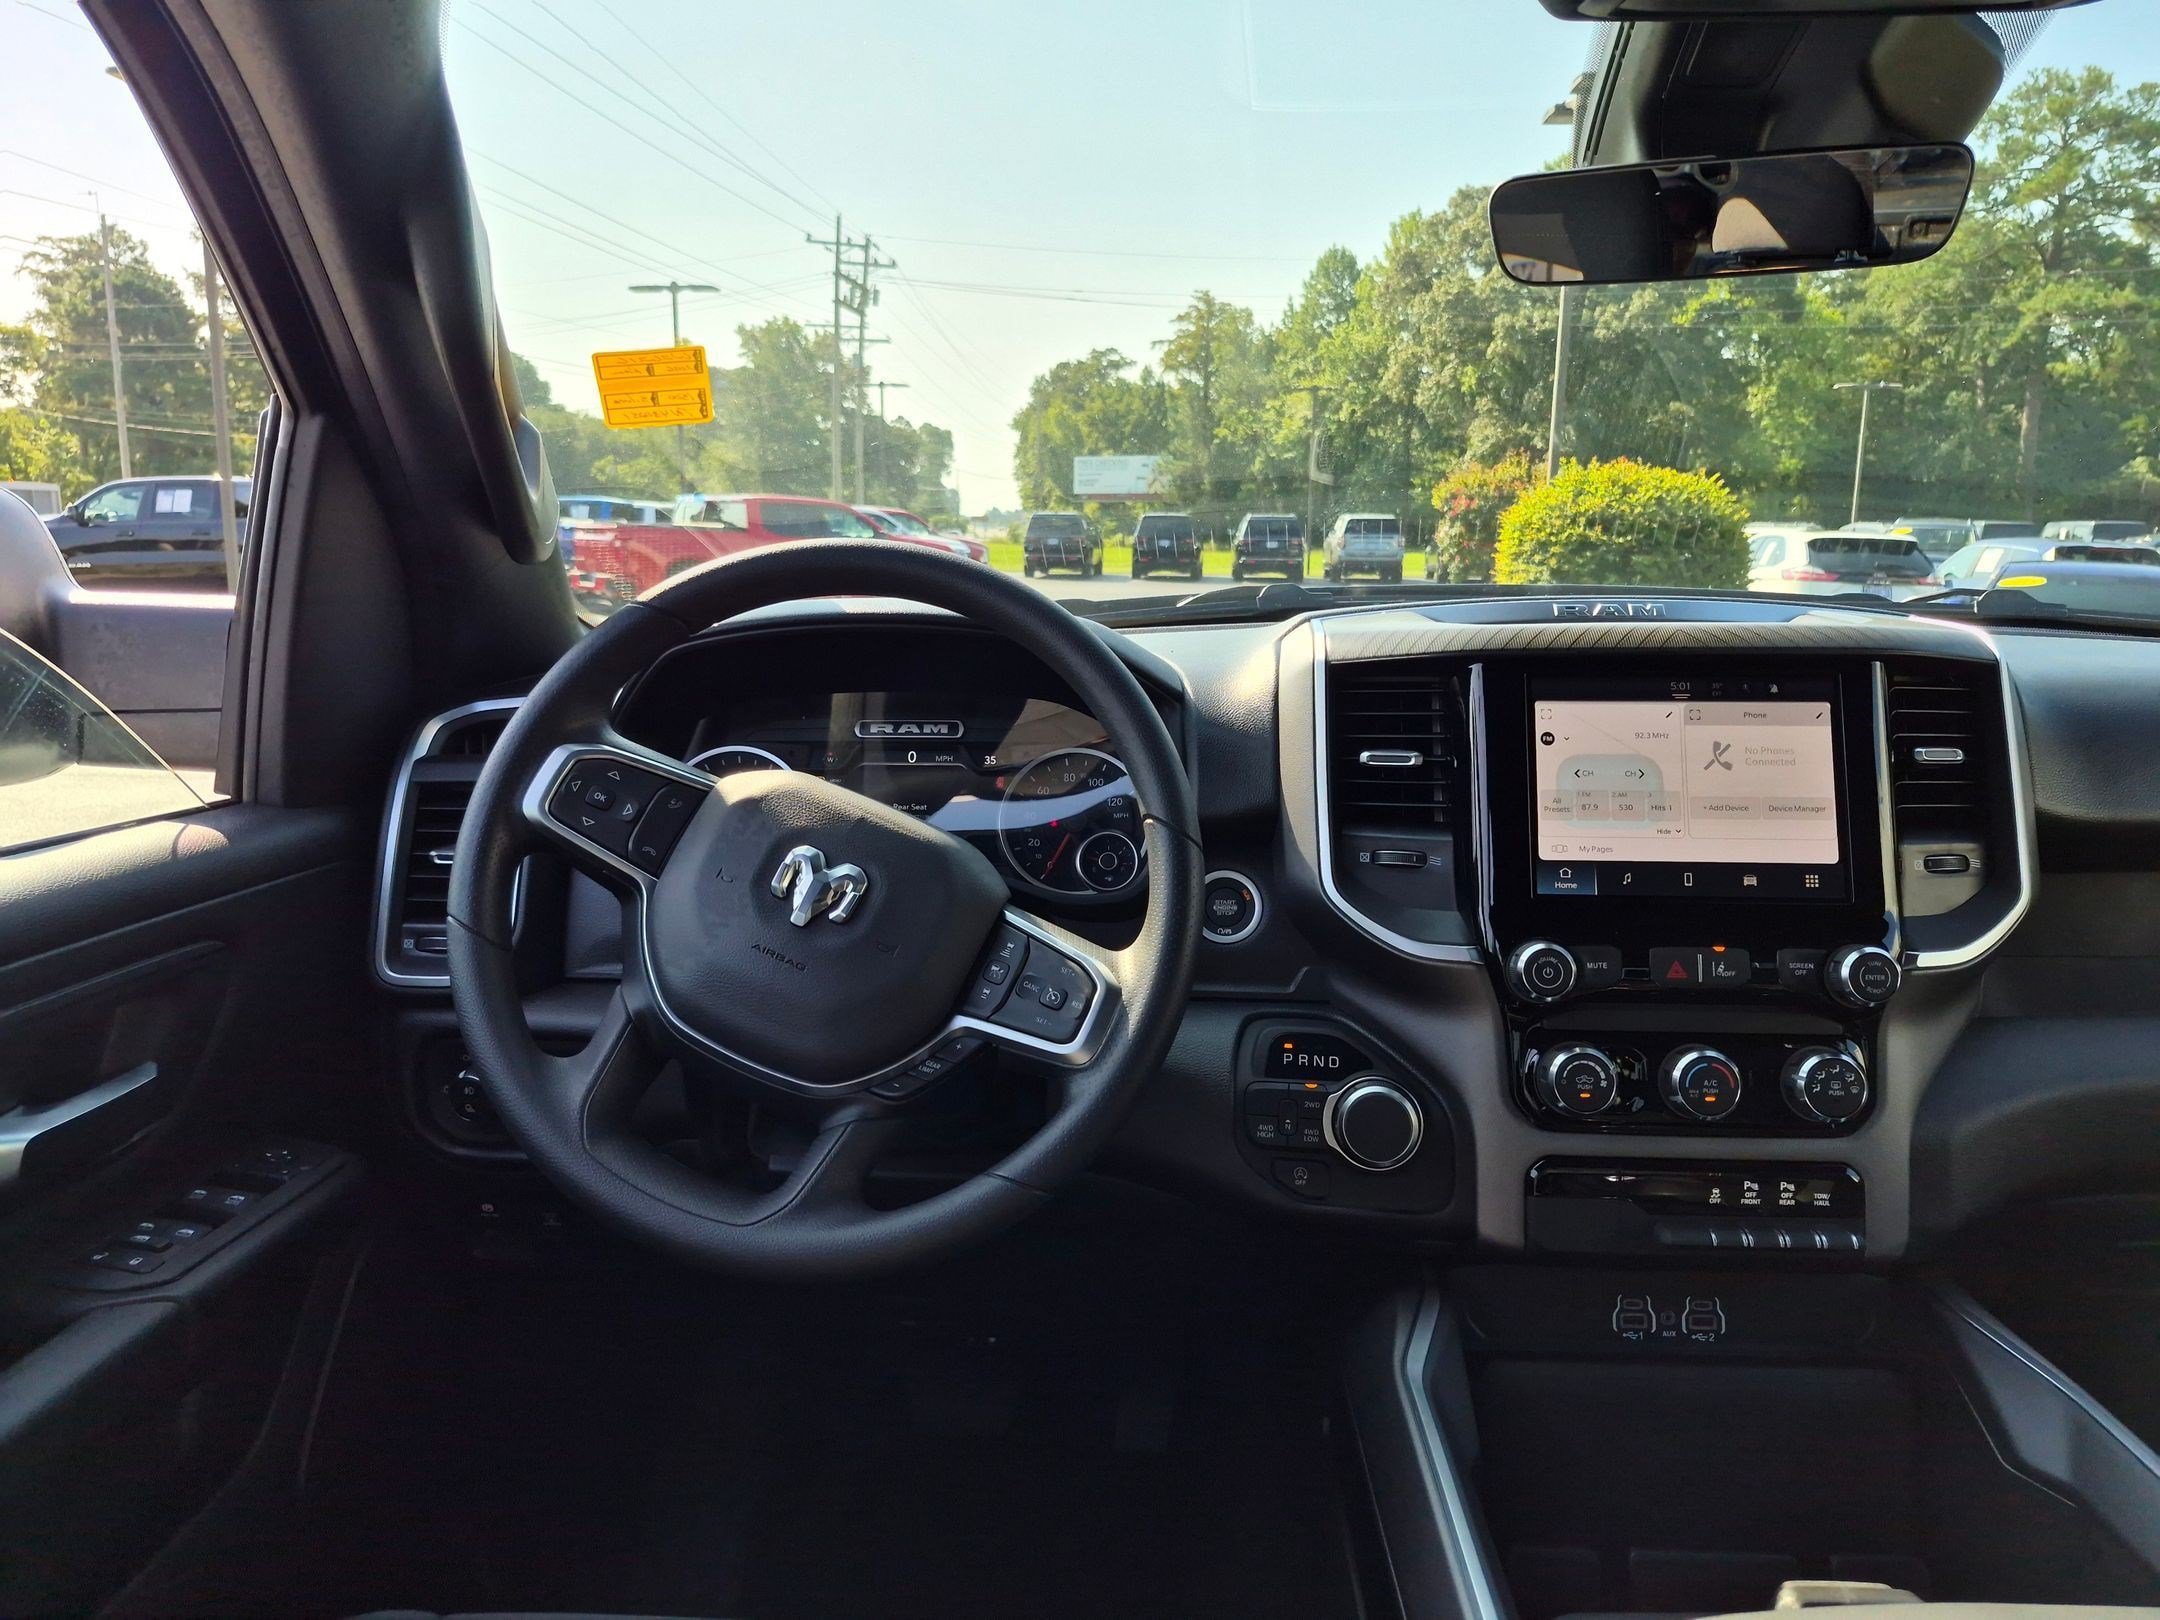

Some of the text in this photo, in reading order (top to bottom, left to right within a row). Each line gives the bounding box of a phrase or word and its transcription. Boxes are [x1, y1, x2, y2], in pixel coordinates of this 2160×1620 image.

[1552, 603, 1666, 617] RAM
[1670, 681, 1691, 692] 5:01
[1743, 711, 1767, 719] Phone
[870, 723, 949, 734] RAM
[1634, 731, 1669, 740] 92.3 MHz
[1745, 747, 1795, 755] No Phones
[907, 751, 917, 764] 0
[984, 755, 997, 766] 35
[1745, 757, 1796, 767] Connected
[1063, 773, 1076, 782] 80
[1624, 770, 1637, 778] CH
[1088, 778, 1104, 787] 100
[1037, 786, 1049, 795] 60
[594, 792, 607, 802] OK
[1108, 797, 1123, 807] 120
[911, 803, 928, 811] Seat
[1709, 804, 1723, 812] Add
[1725, 804, 1750, 812] Device
[1769, 804, 1826, 814] Device Manager
[1028, 838, 1041, 847] 20
[1579, 845, 1613, 855] My Pages
[1554, 881, 1578, 890] Home
[751, 942, 807, 972] AIRBAG
[1023, 981, 1040, 993] CANC
[918, 1063, 935, 1074] LIMIT
[925, 1059, 942, 1071] GEAR
[1285, 1123, 1291, 1131] N
[1257, 1131, 1274, 1139] HIGH
